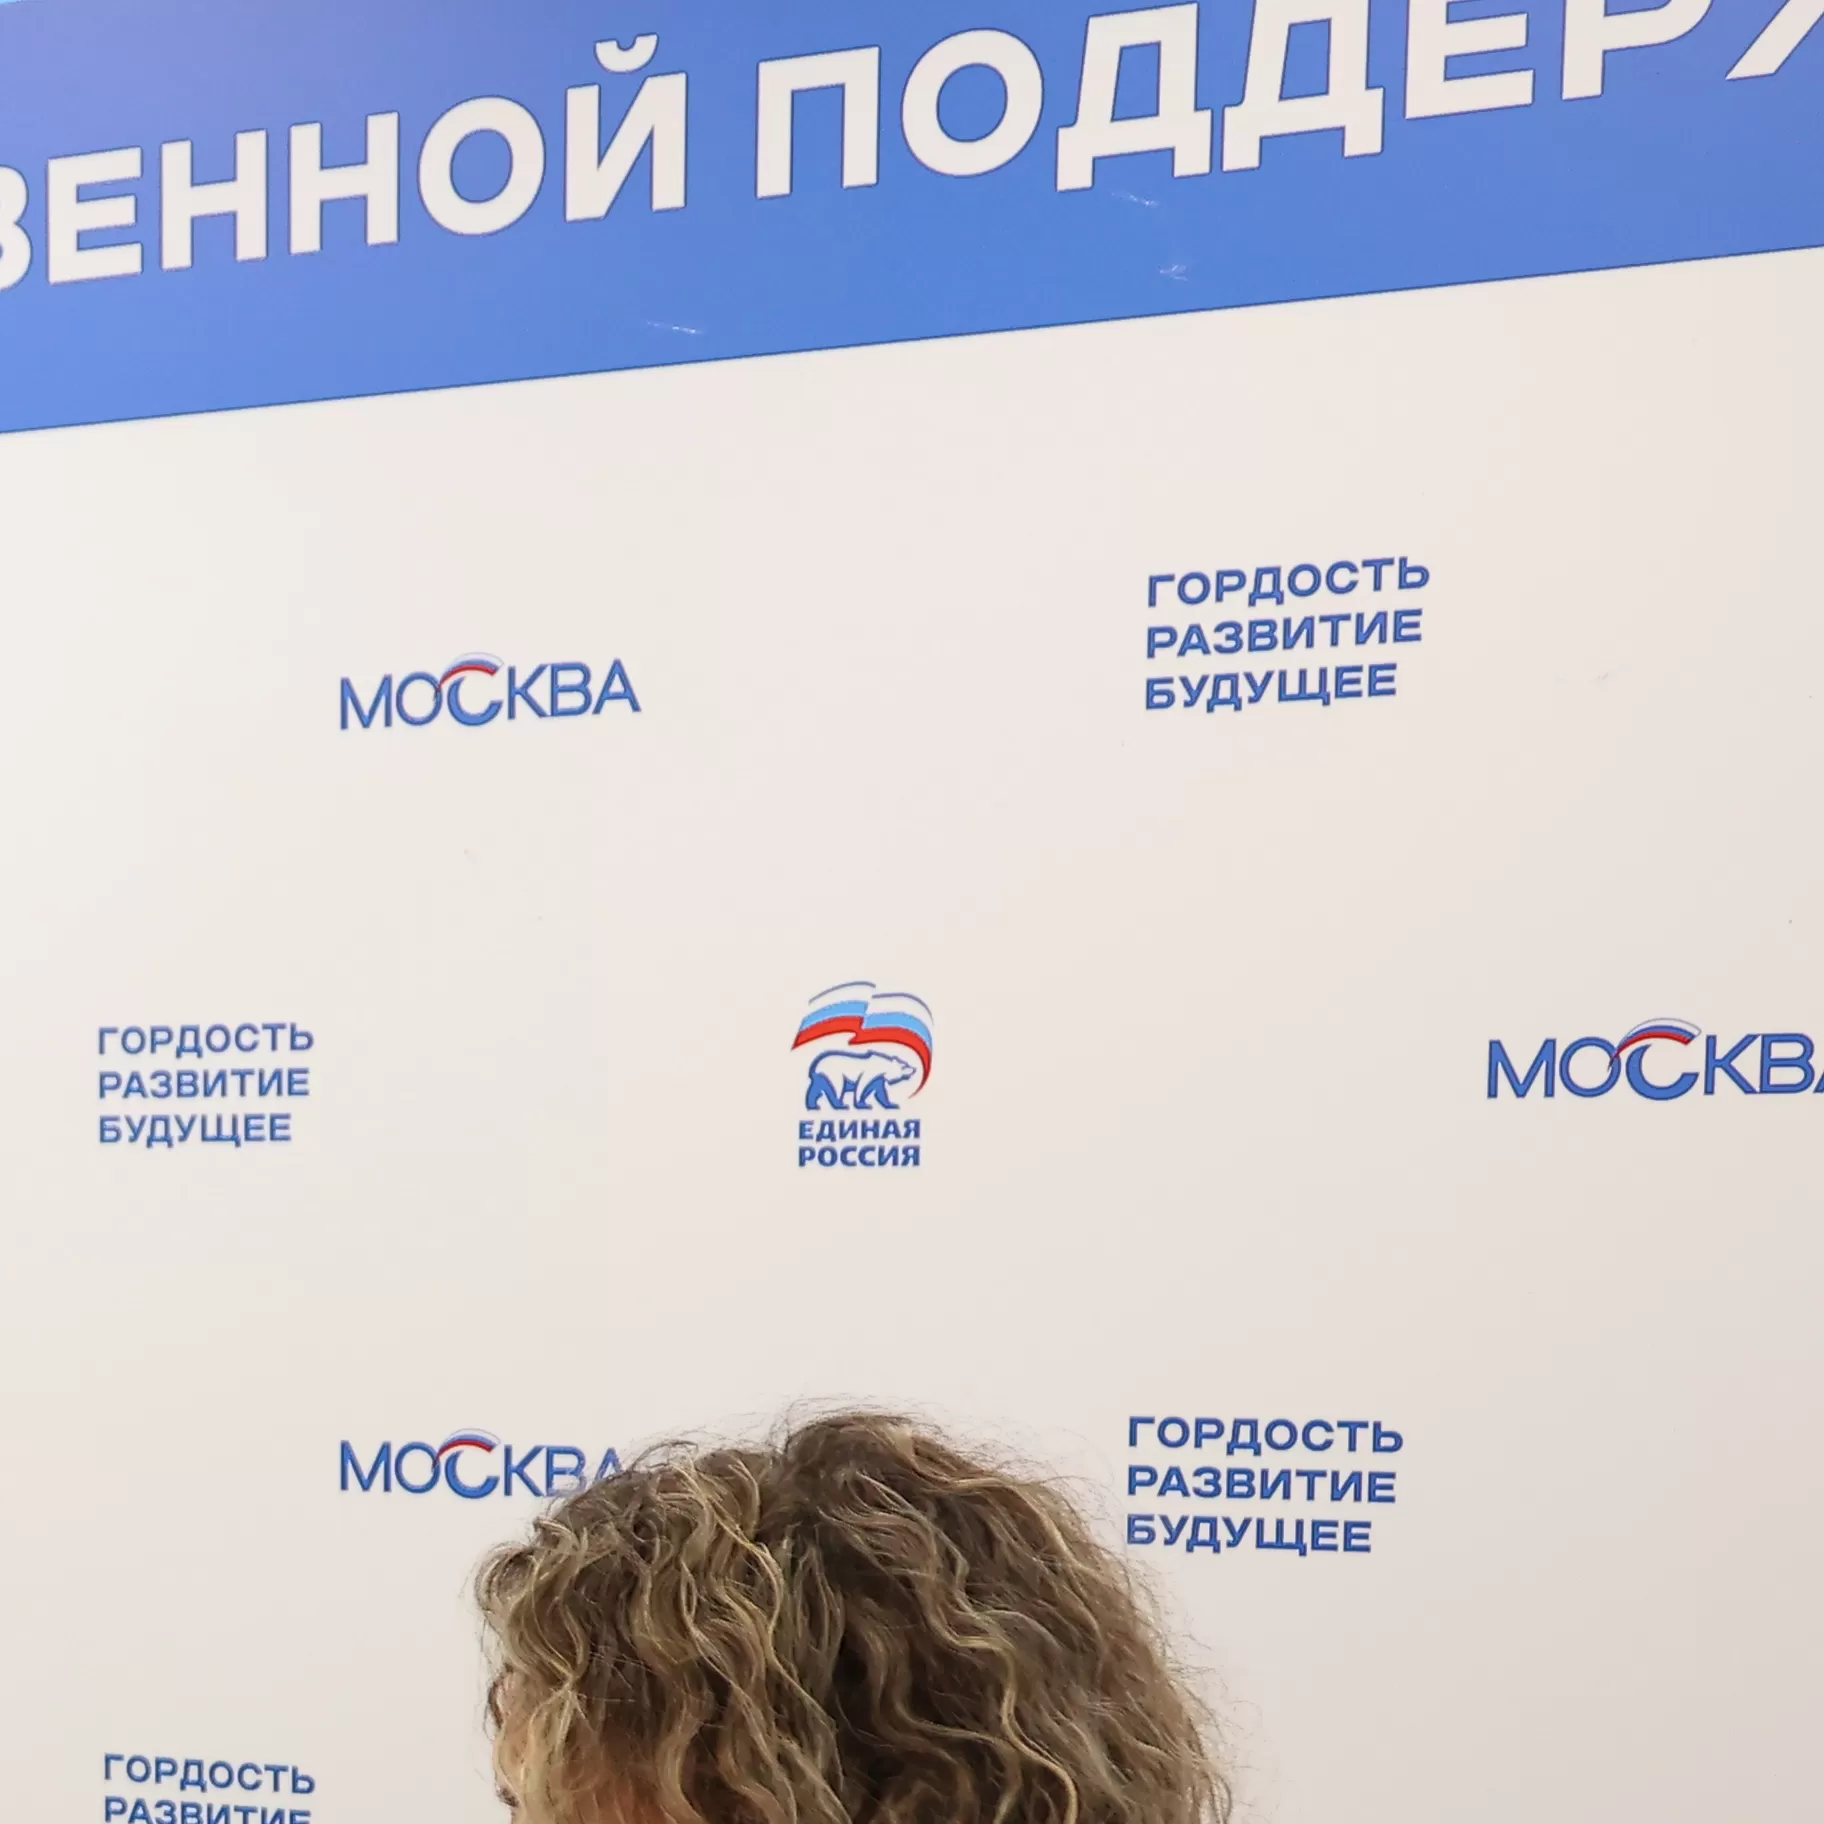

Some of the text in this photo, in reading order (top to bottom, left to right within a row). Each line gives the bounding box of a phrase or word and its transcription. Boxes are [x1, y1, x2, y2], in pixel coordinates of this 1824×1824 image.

[1147, 555, 1431, 608] ГОРДОСТЬ
[1146, 608, 1423, 660] РАЗВИТИЕ
[340, 653, 641, 730] МОСКВА
[1145, 662, 1398, 714] БУДУЩЕЕ
[98, 1022, 314, 1059] ГОРДОСТЬ
[1486, 1019, 1824, 1102] МОСКВ
[98, 1067, 310, 1100] РАЗВИТИЕ
[99, 1112, 292, 1149] БУДУЩЕЕ
[798, 1118, 921, 1142] ЕДИНАЯ
[798, 1144, 921, 1168] РОССИЯ
[1128, 1415, 1404, 1457] ГОРДОСТЬ
[1127, 1464, 1397, 1504] РАЗВИТИЕ
[1126, 1513, 1372, 1557] БУДУЩЕЕ
[103, 1753, 316, 1795] ГОРДОСТЬ
